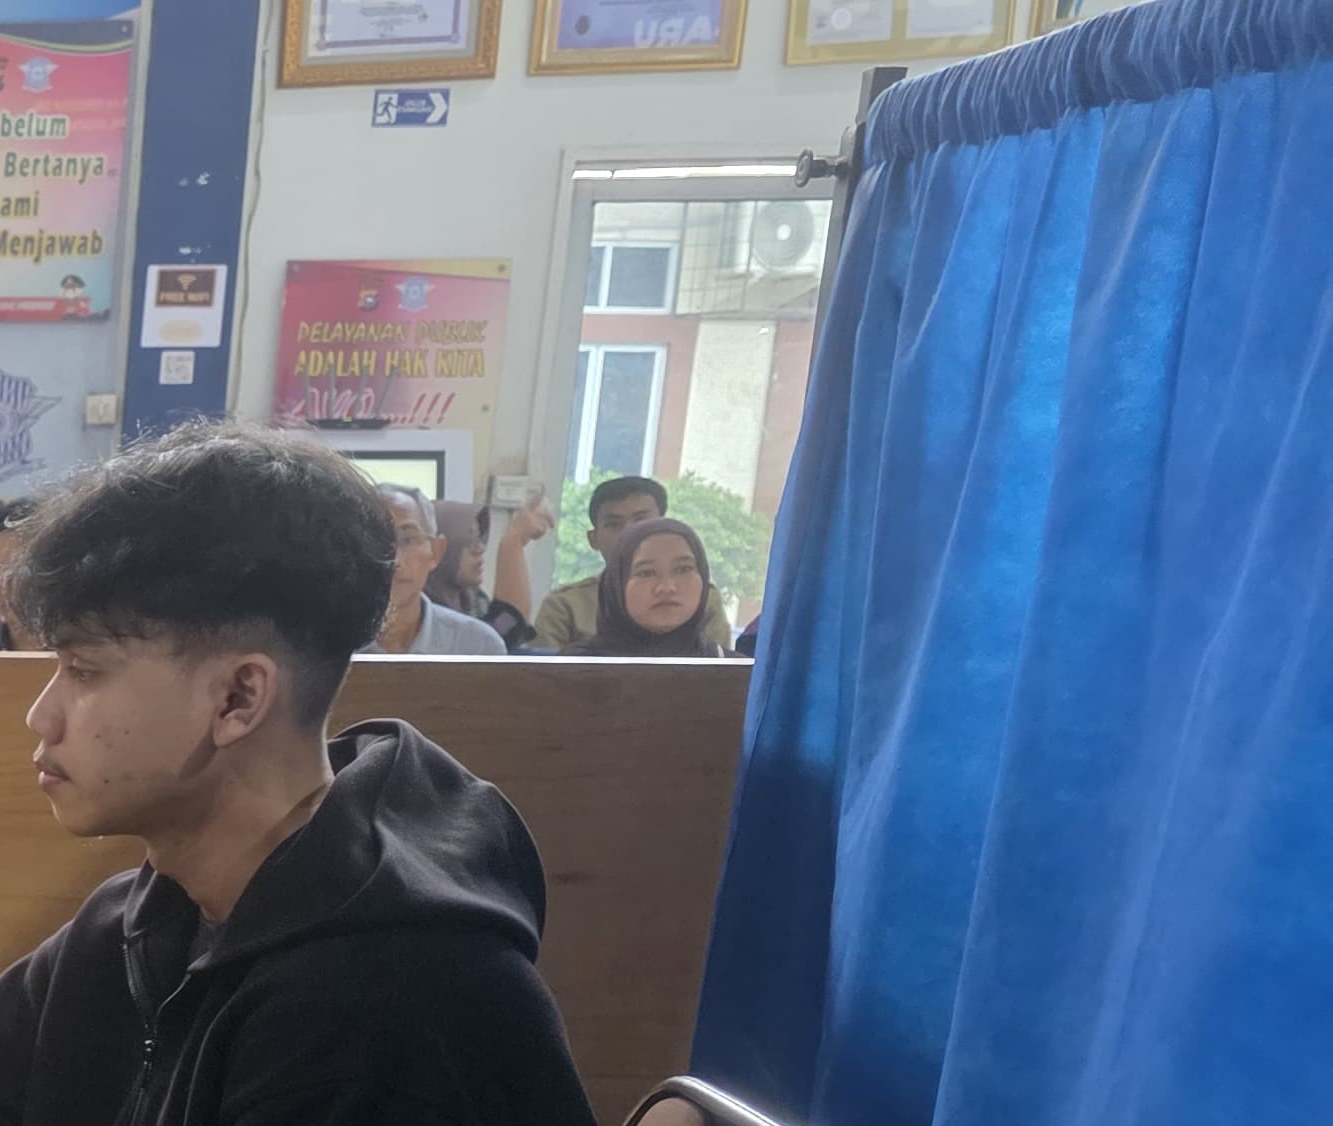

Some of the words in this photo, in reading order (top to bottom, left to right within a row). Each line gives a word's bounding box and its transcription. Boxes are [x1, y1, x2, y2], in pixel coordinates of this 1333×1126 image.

[4, 152, 105, 185] Bertanya
[297, 320, 407, 343] PELAYANAN
[294, 349, 377, 377] ADALAH
[385, 348, 429, 377] HAK
[435, 348, 485, 377] KITA
